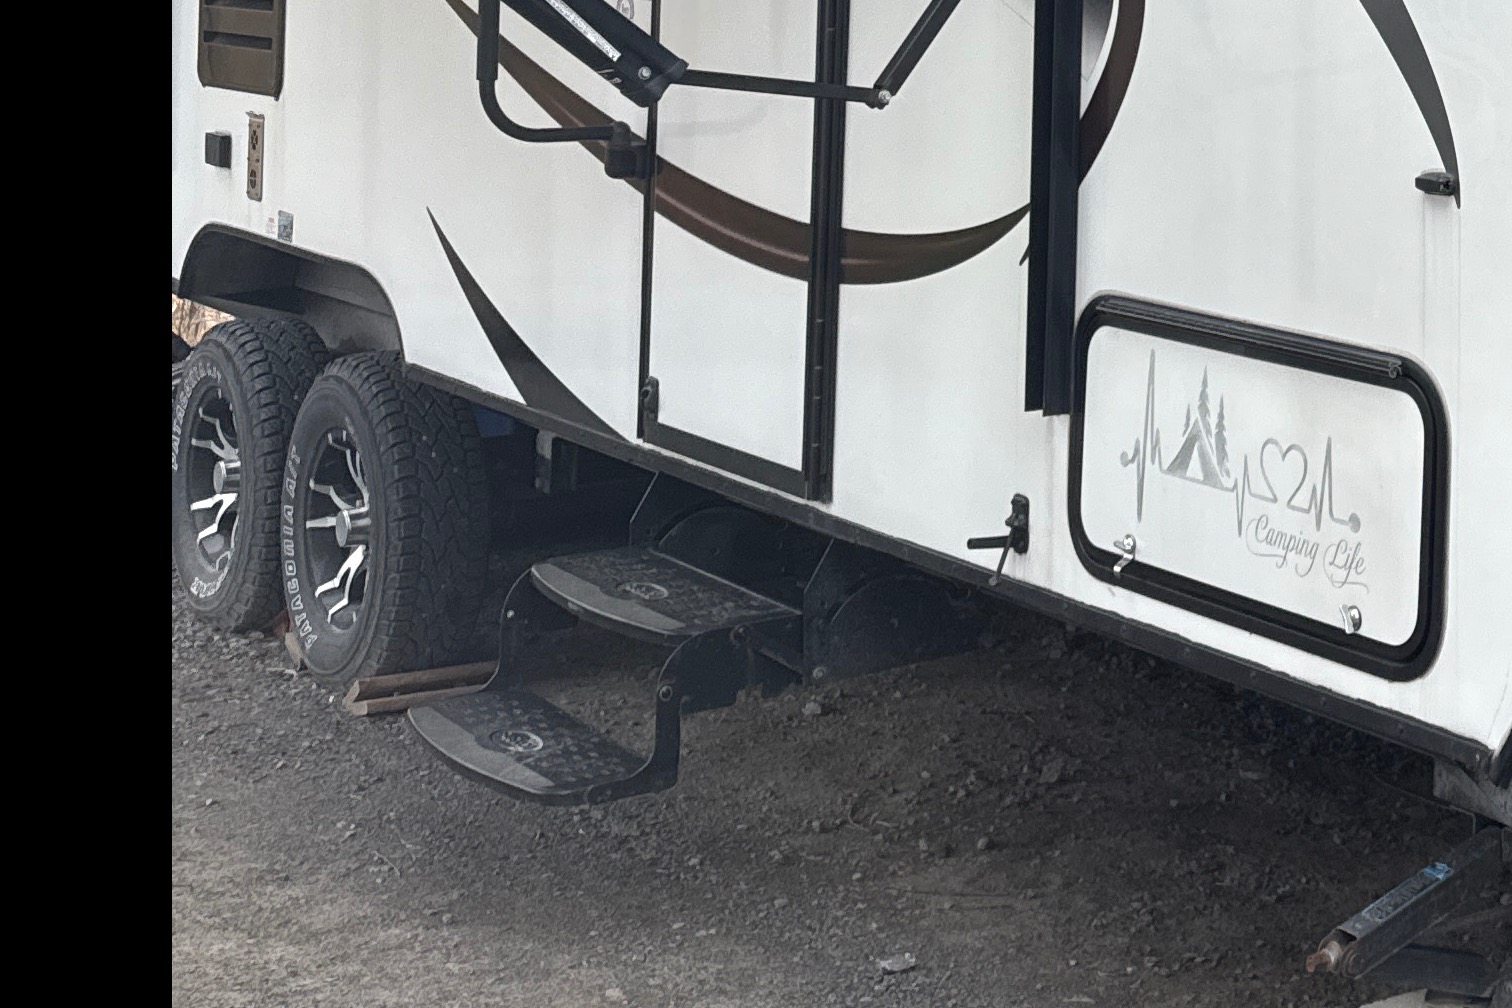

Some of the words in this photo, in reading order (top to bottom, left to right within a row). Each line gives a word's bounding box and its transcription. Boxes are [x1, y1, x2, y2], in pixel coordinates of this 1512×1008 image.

[282, 505, 318, 651] PATAGONIA
[1245, 514, 1320, 578] Camping
[1323, 539, 1369, 594] Life
